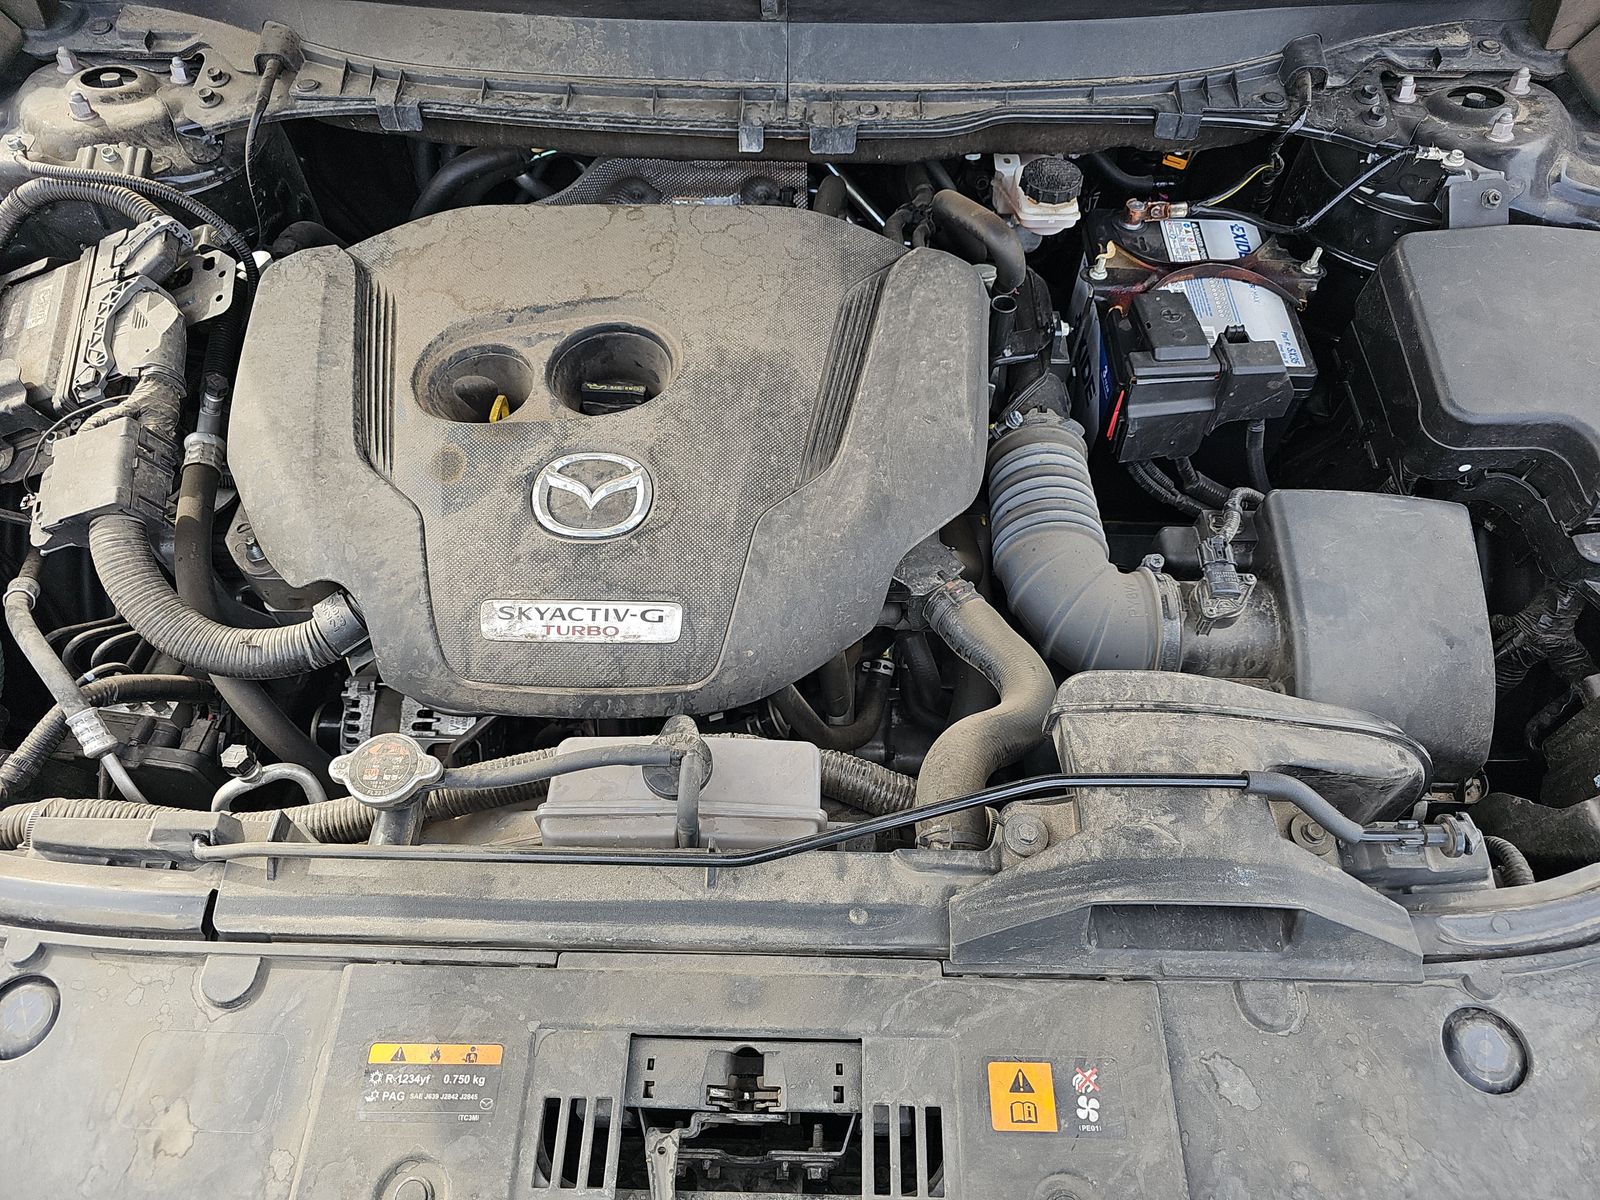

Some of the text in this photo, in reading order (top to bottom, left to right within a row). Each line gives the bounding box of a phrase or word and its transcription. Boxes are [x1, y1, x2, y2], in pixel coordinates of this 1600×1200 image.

[498, 605, 665, 623] SKYACTIV-G
[542, 624, 620, 637] TURBO
[443, 1074, 470, 1084] 0.750
[472, 1074, 486, 1087] kg
[382, 1091, 406, 1102] PAG
